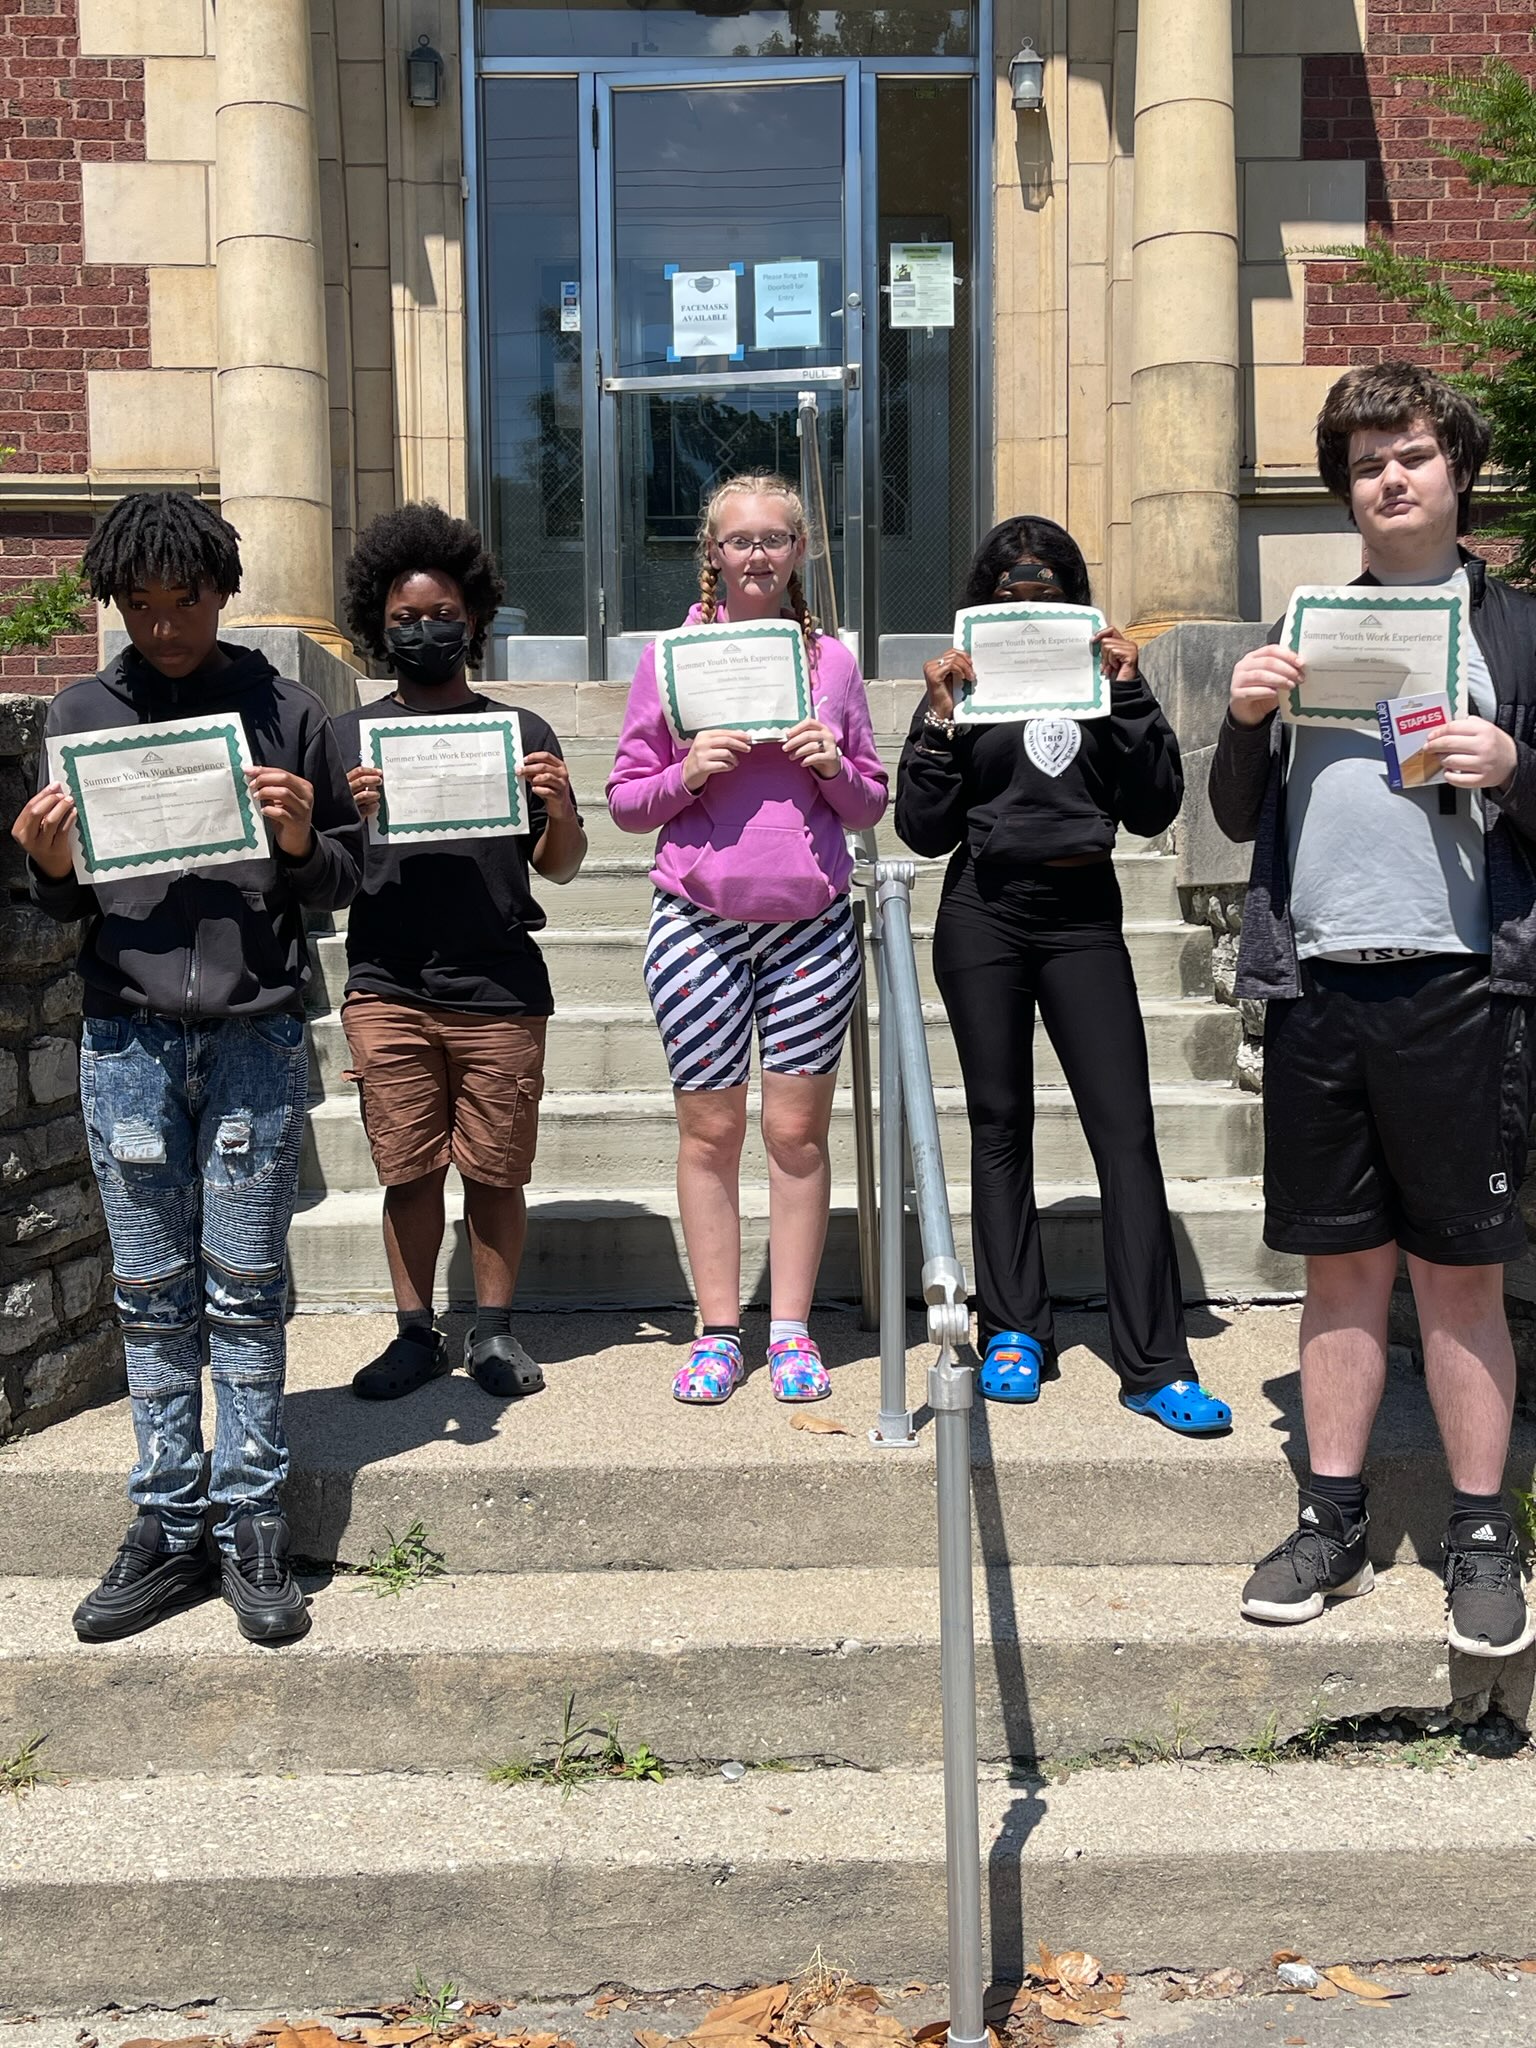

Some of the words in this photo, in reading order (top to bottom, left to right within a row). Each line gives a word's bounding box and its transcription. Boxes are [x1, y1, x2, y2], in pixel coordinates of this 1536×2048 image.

[763, 273, 782, 281] Please
[783, 272, 797, 281] Ring
[798, 272, 808, 280] the
[767, 283, 794, 291] Doorbell
[795, 282, 804, 290] for
[778, 294, 795, 302] Entry
[681, 303, 729, 312] FACEMASKS
[682, 314, 728, 322] AVAILABLE
[802, 369, 827, 379] PULL
[974, 640, 1004, 649] Summer
[1004, 638, 1026, 647] Youth
[1028, 638, 1047, 646] Work
[1048, 636, 1087, 647] Experience
[1303, 630, 1337, 641] Summer
[1339, 631, 1364, 641] Youth
[1366, 632, 1390, 641] Work
[1392, 633, 1443, 644] Experience
[676, 662, 706, 670] Summer
[750, 654, 789, 665] Experience
[1377, 703, 1390, 723] rule
[1399, 711, 1442, 730] STAPLES
[1381, 726, 1394, 747] you
[1029, 730, 1048, 768] UNIVERSITY
[1057, 729, 1078, 768] CINCINNATI
[385, 755, 415, 763] Summer
[461, 751, 500, 760] Experience
[83, 775, 121, 788] Summer
[122, 770, 149, 782] Youth
[150, 766, 175, 778] Work
[176, 761, 225, 776] Experience
[1471, 1533, 1497, 1542] adidas
